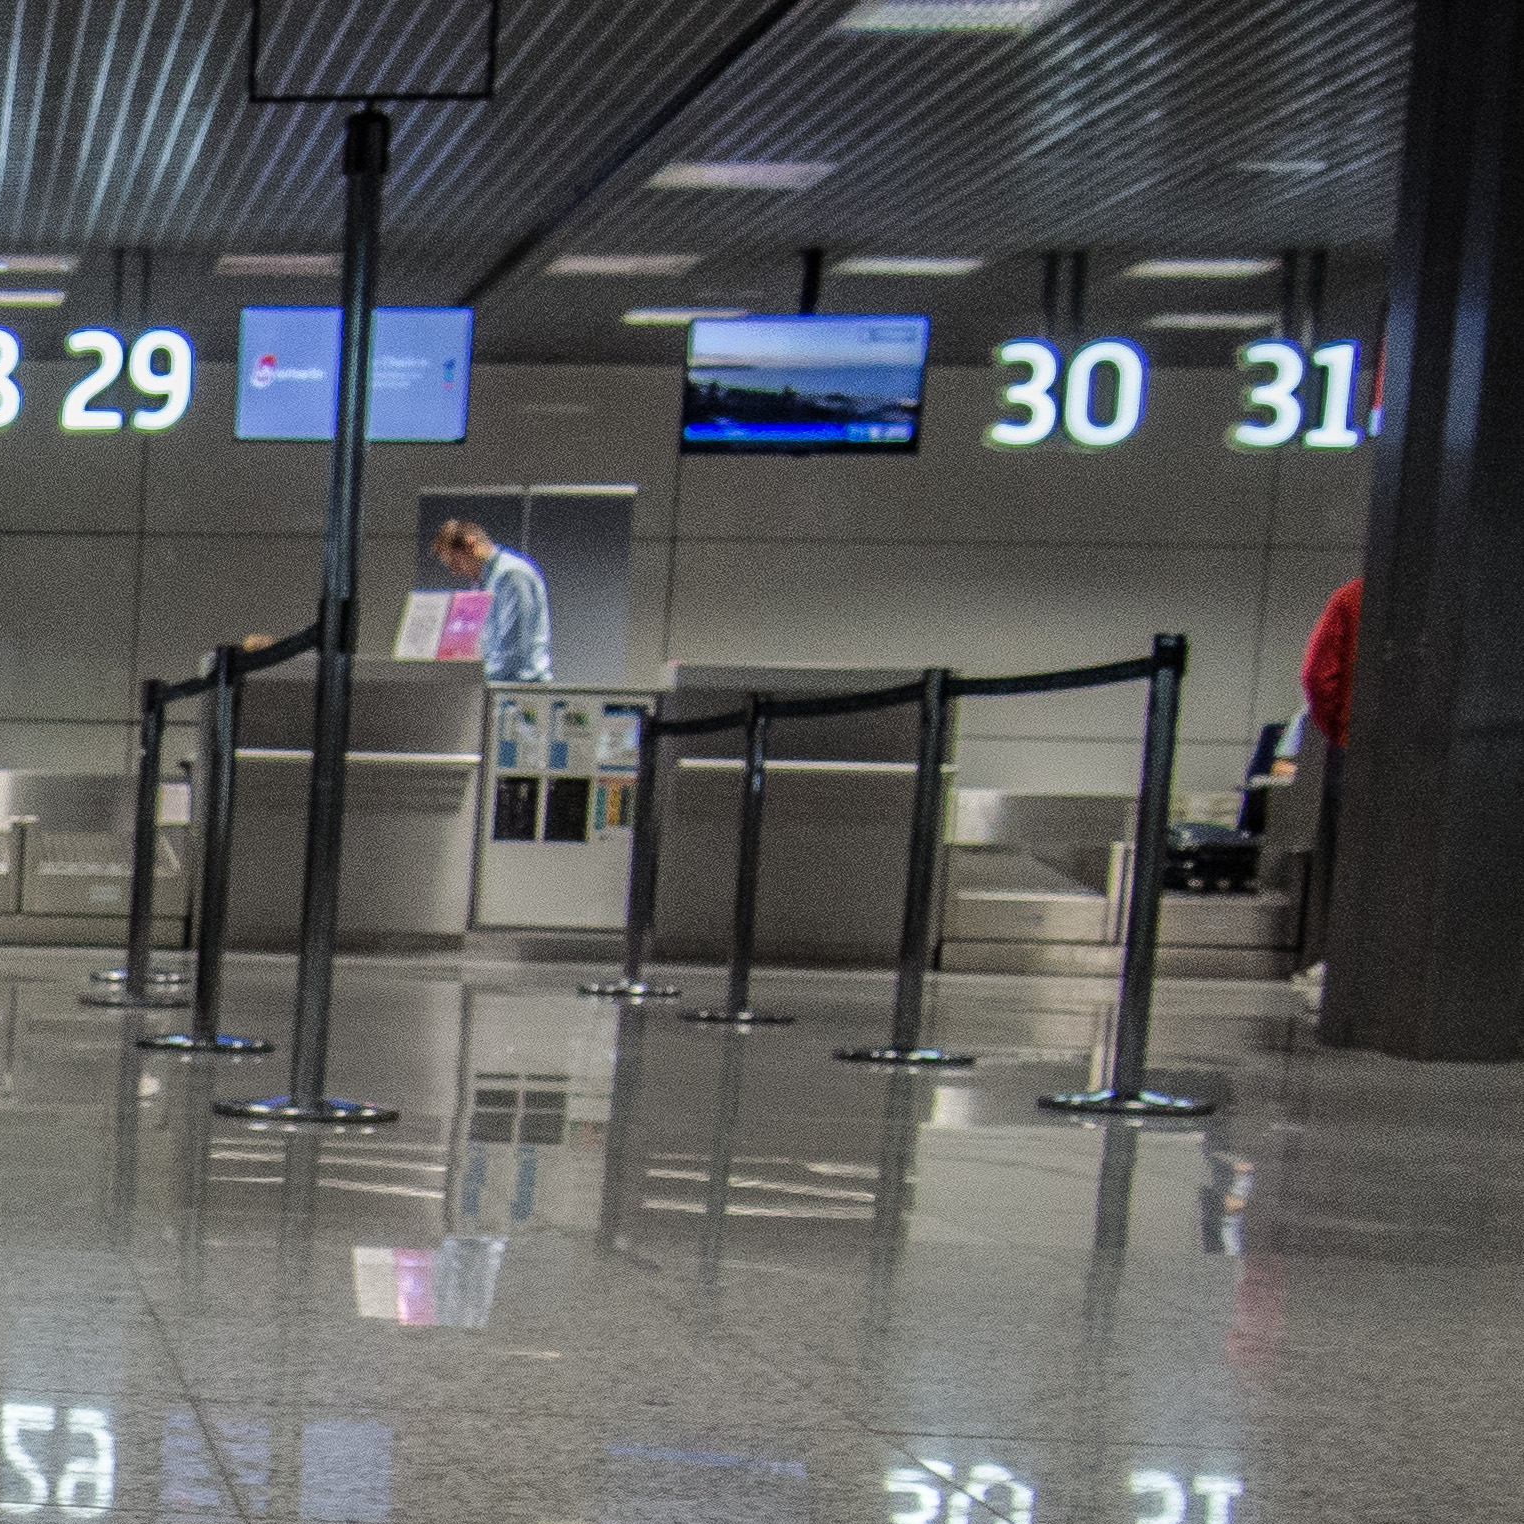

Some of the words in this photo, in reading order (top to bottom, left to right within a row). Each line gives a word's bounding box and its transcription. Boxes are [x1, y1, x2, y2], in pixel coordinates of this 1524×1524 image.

[59, 328, 193, 432] 29
[989, 341, 1147, 447] 30
[1233, 341, 1361, 448] 31
